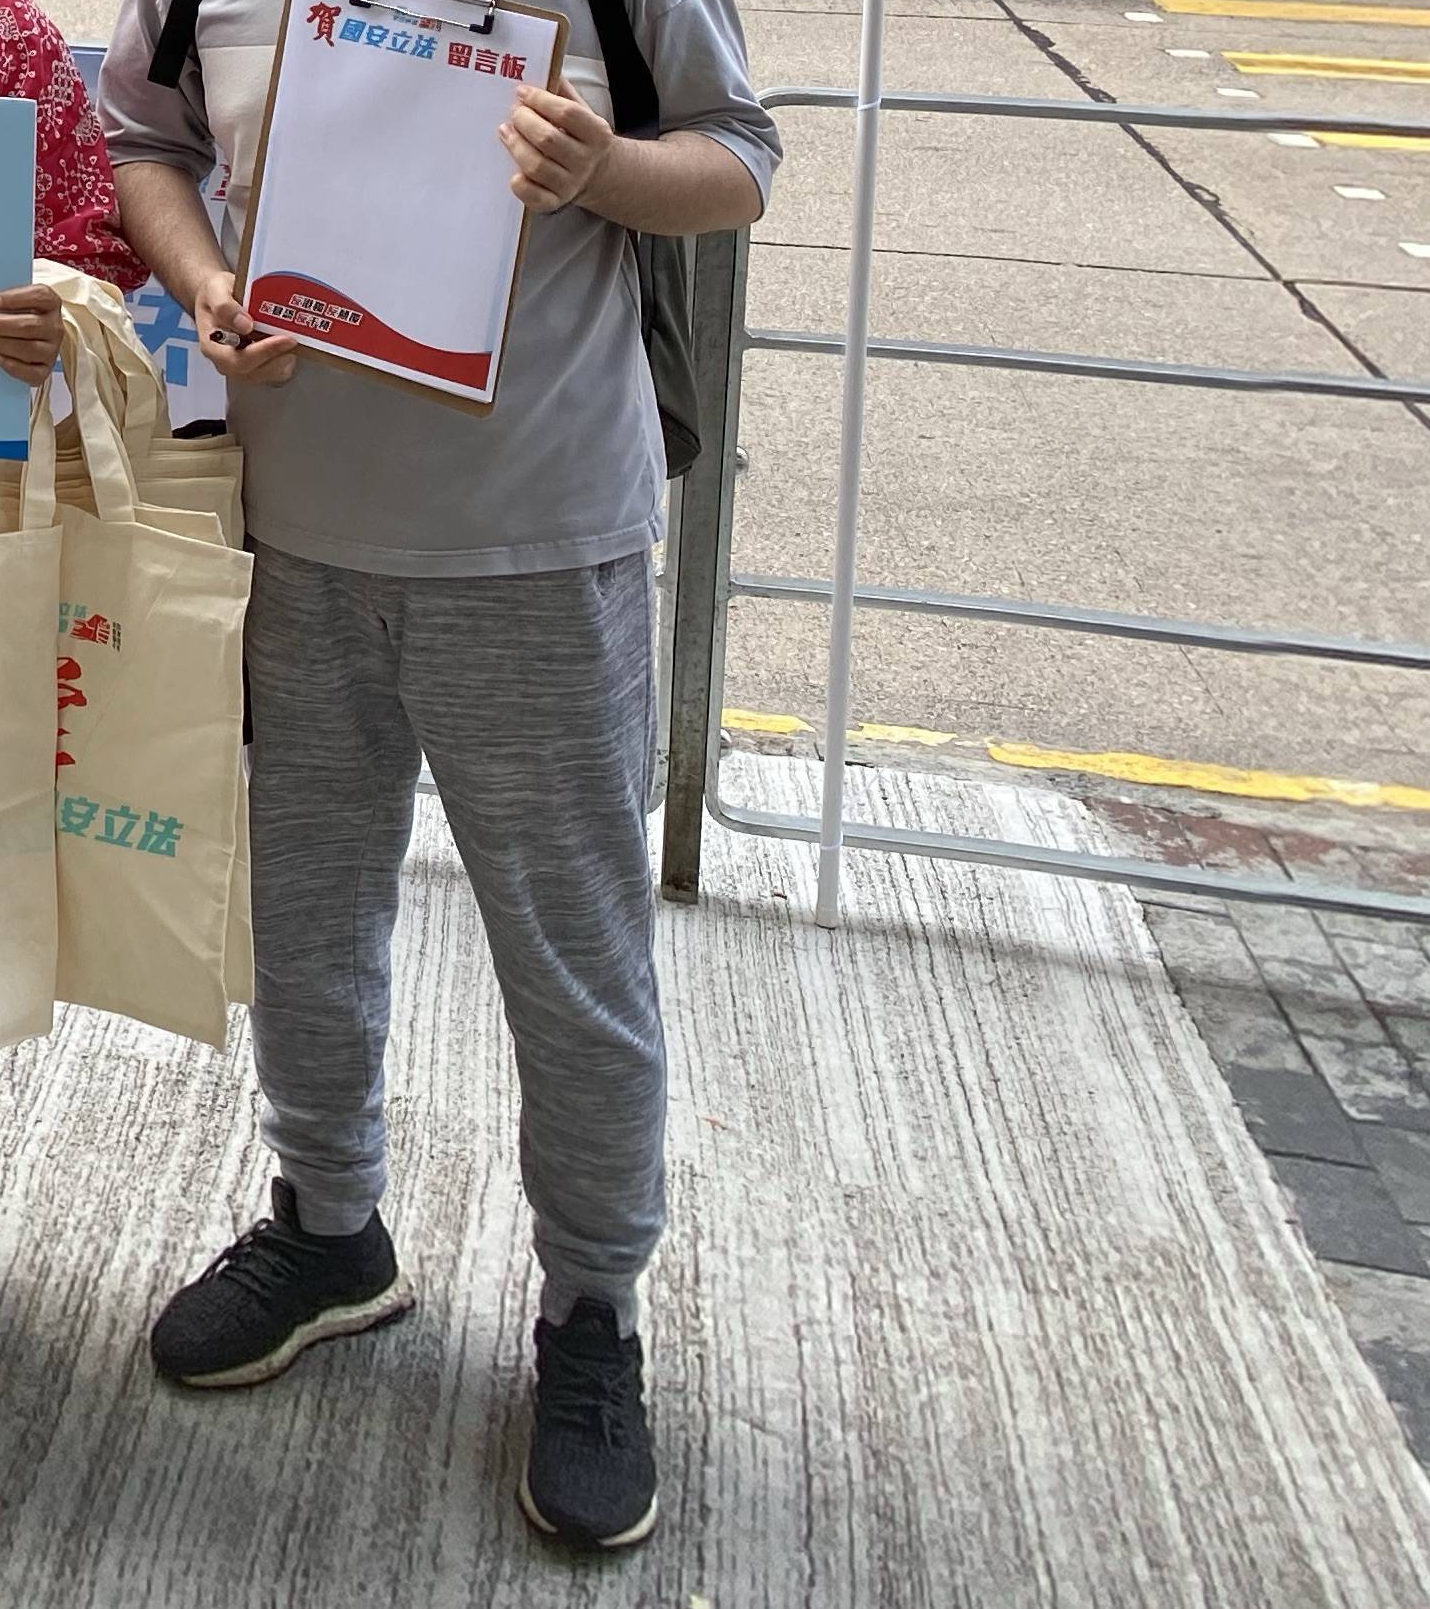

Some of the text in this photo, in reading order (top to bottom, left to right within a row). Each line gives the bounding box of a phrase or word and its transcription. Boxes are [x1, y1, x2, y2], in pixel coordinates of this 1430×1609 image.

[447, 42, 528, 82] 留言板
[55, 796, 185, 859] 安立法
